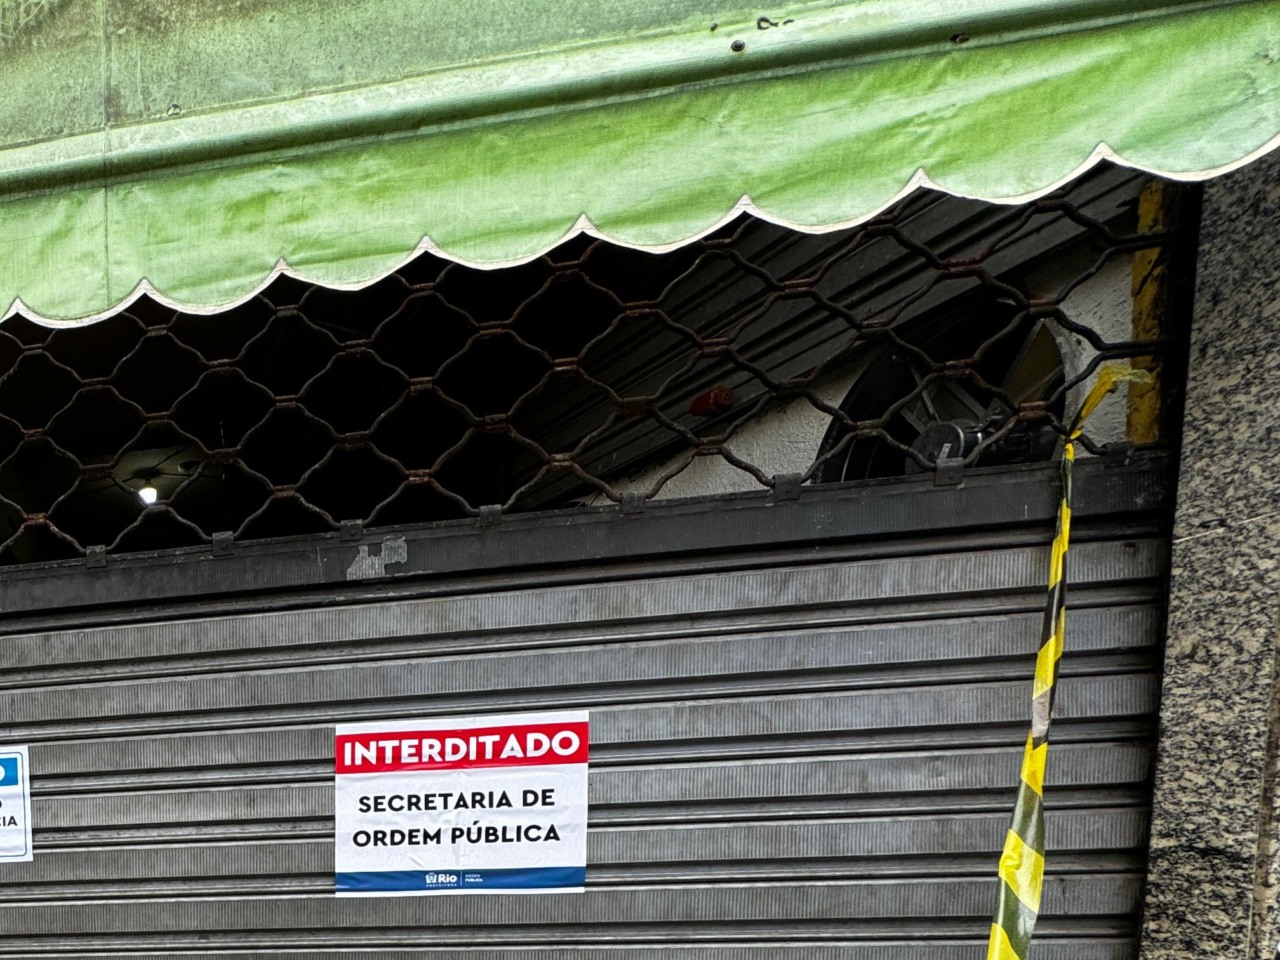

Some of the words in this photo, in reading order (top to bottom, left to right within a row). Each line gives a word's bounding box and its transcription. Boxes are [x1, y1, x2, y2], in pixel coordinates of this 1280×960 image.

[344, 730, 580, 766] INTERDITADO
[358, 790, 512, 813] SECRETARIA
[522, 788, 555, 807] DE
[352, 827, 442, 847] ORDEM
[451, 821, 560, 844] PÚBLICA
[438, 874, 457, 883] Rio
